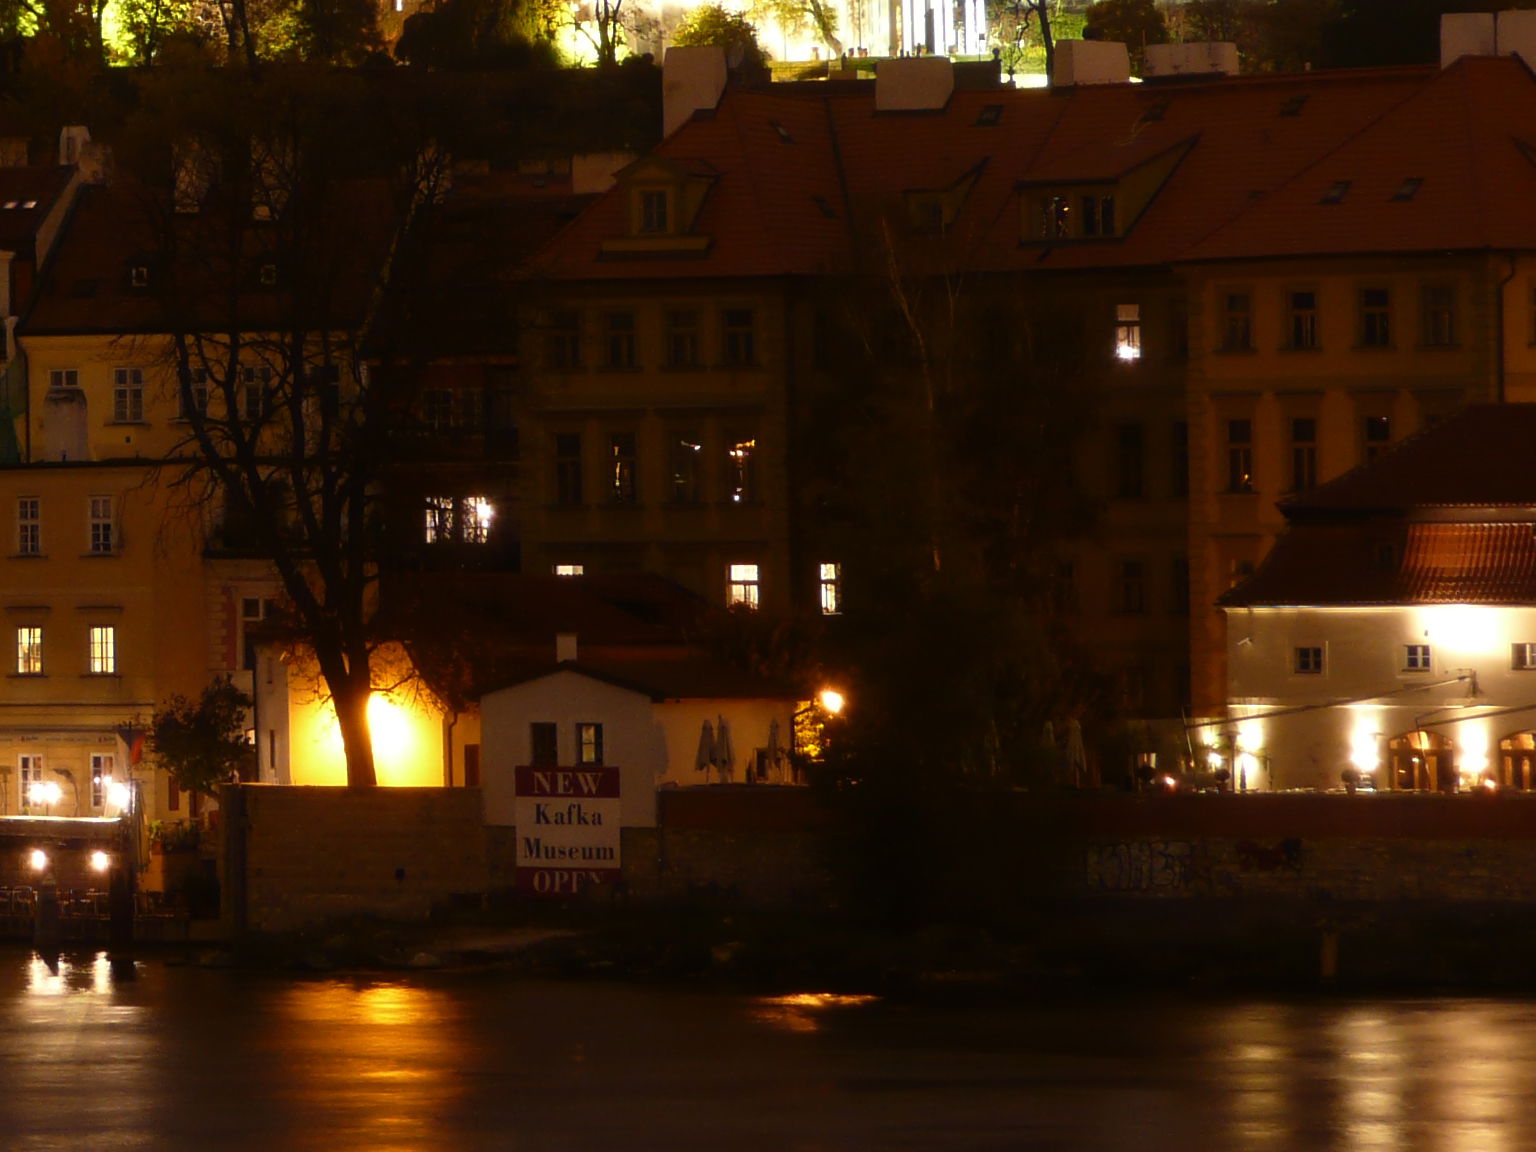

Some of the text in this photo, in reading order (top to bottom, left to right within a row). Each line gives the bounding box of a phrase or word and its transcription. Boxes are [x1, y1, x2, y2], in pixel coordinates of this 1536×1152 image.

[533, 772, 602, 795] NEW
[535, 804, 603, 825] Kafka
[524, 837, 615, 860] Museum
